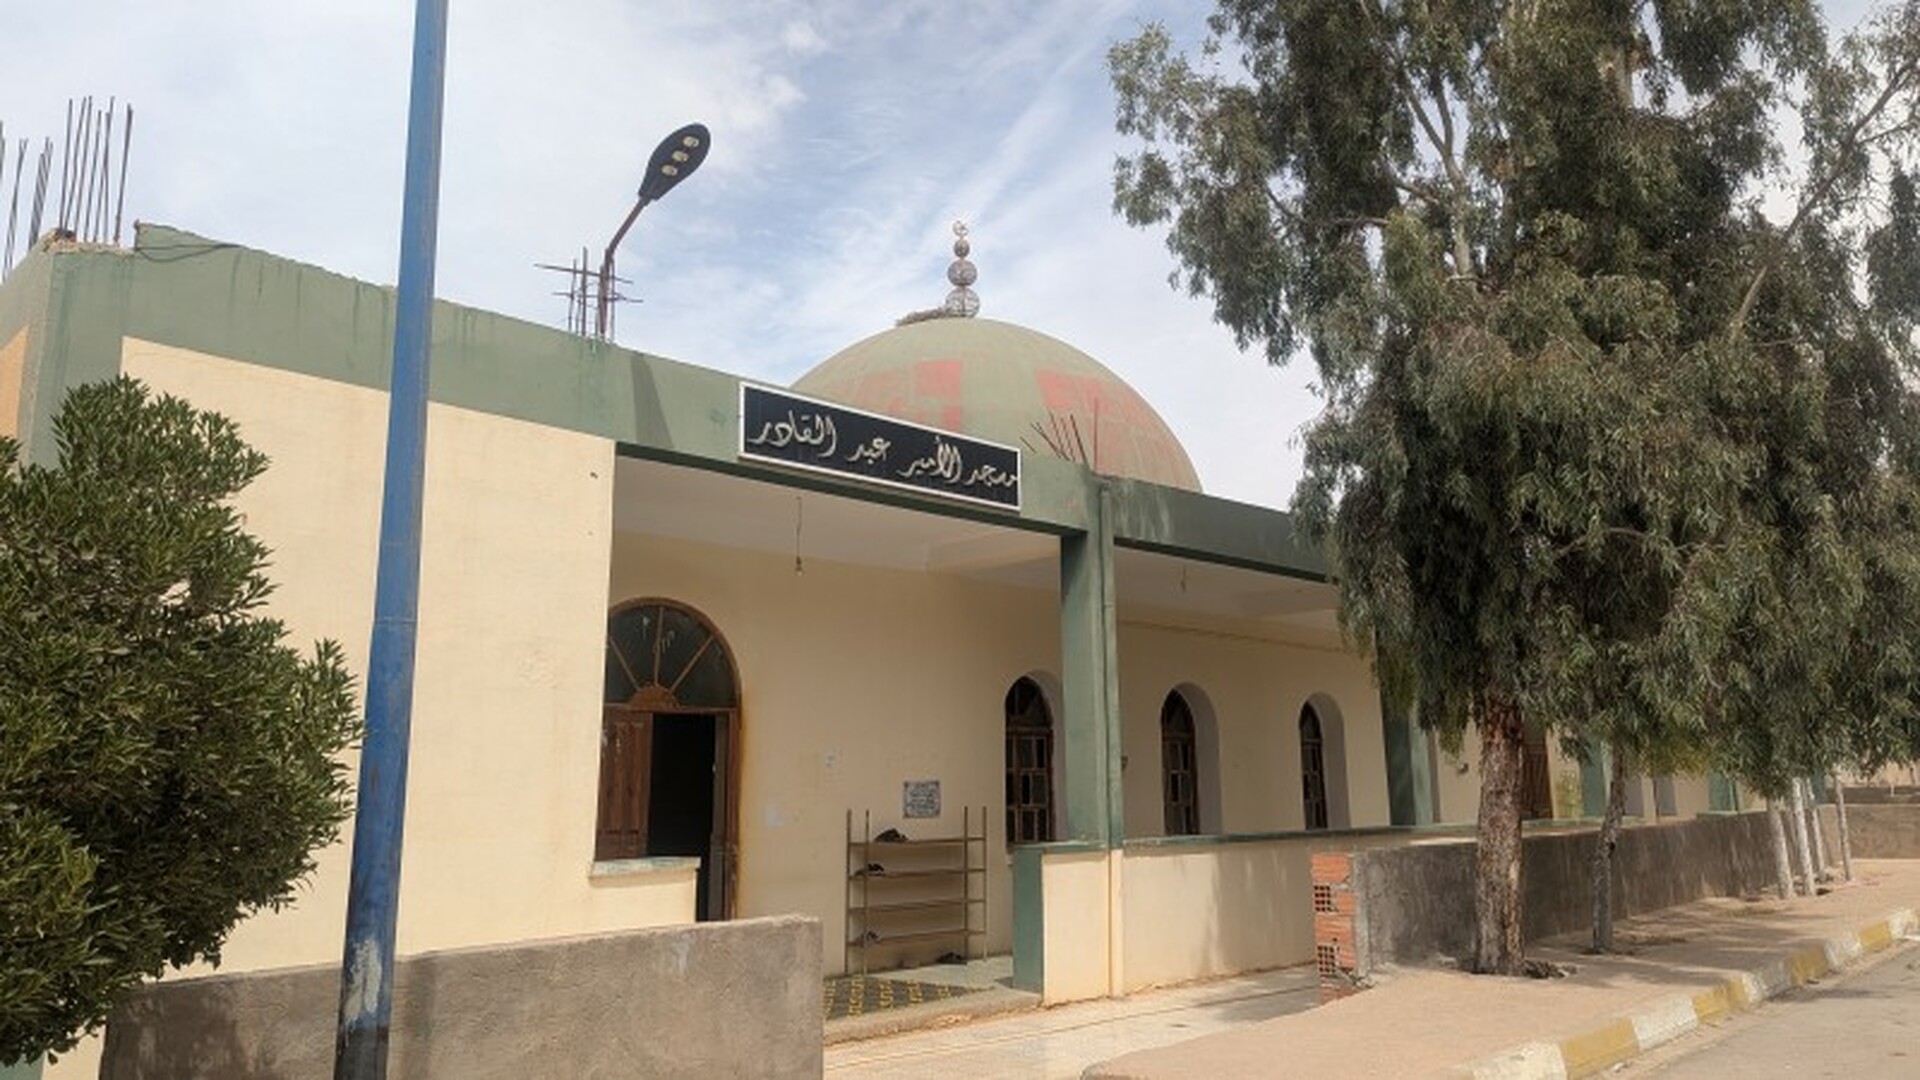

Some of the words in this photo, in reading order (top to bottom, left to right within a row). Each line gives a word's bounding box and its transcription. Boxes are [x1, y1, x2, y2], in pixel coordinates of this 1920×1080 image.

[748, 410, 837, 457] القادر
[847, 437, 891, 464] عبد
[964, 464, 1018, 487] مسجد
